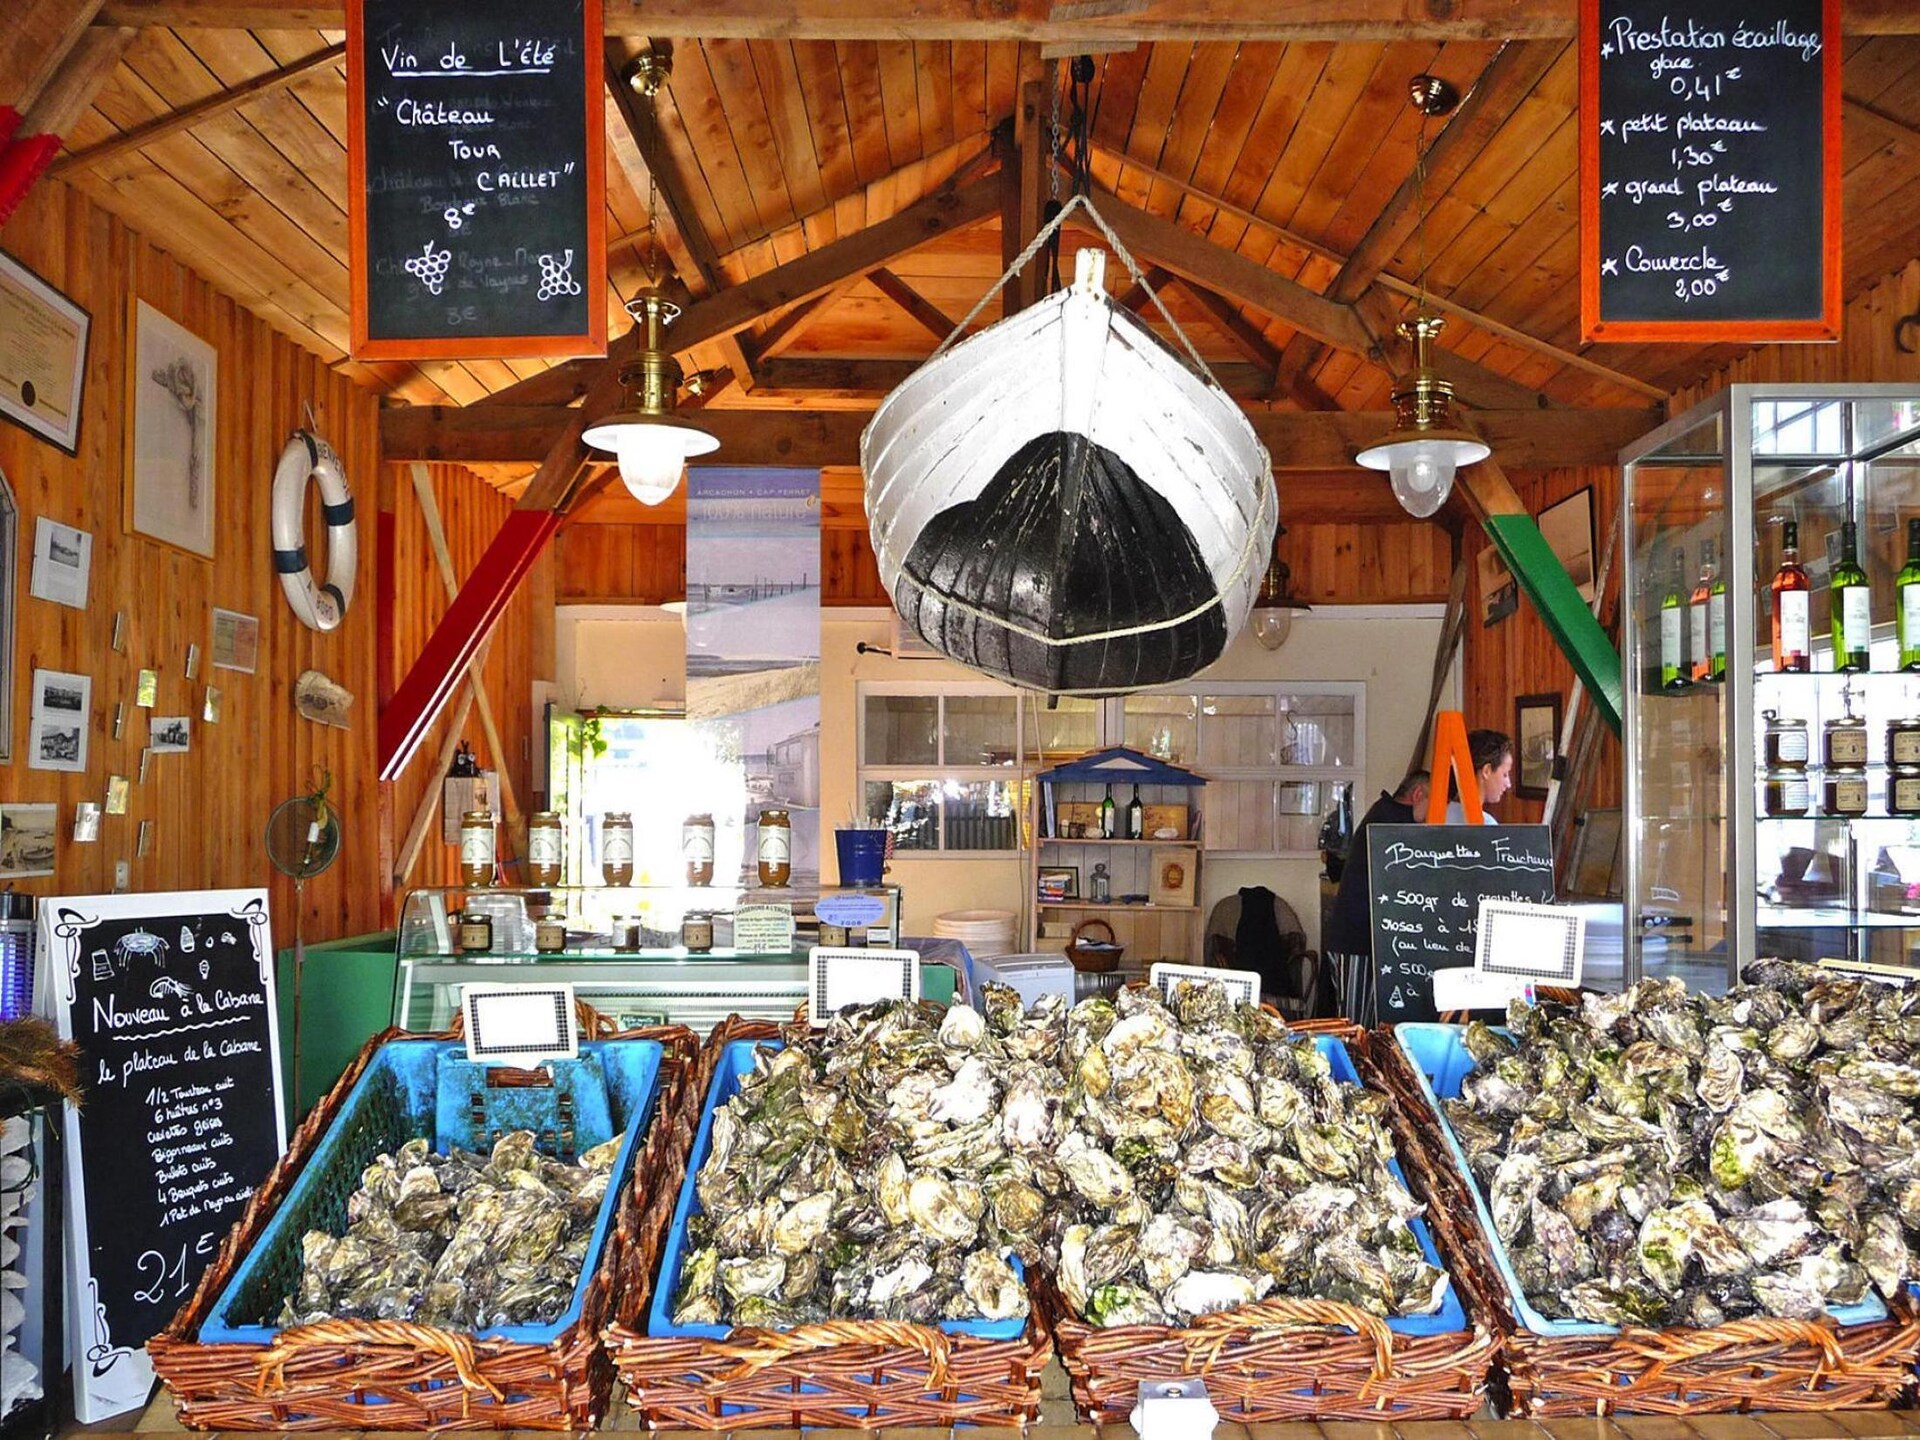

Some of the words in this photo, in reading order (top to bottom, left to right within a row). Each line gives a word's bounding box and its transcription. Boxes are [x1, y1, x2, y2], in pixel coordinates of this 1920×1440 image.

[1609, 16, 1724, 54] Prestation
[381, 44, 417, 70] Vin
[440, 42, 473, 69] de
[1650, 54, 1694, 79] glace
[1621, 114, 1668, 143] petit
[1676, 113, 1768, 139] plateau
[1625, 177, 1684, 204] grand
[1697, 173, 1778, 206] plateau
[1625, 245, 1726, 272] Couvercle
[750, 500, 807, 520] nature
[1394, 889, 1439, 912] 500gr
[1451, 891, 1469, 907] de
[1437, 917, 1450, 933] à
[1423, 937, 1449, 951] lieu
[1455, 941, 1474, 953] de
[1406, 982, 1420, 997] à
[93, 993, 170, 1033] Nouveau
[180, 998, 194, 1017] à
[195, 993, 213, 1014] la
[215, 989, 264, 1011] Cabane
[97, 1058, 116, 1085] le
[123, 1048, 178, 1088] plateau
[184, 1045, 201, 1061] de
[203, 1040, 216, 1058] la
[220, 1039, 262, 1056] Cabane
[145, 1086, 169, 1106] 1/2
[154, 1108, 164, 1124] 6
[155, 1164, 188, 1184] Bulots
[158, 1188, 167, 1205] 4
[160, 1212, 169, 1227] 1
[189, 1204, 201, 1216] de
